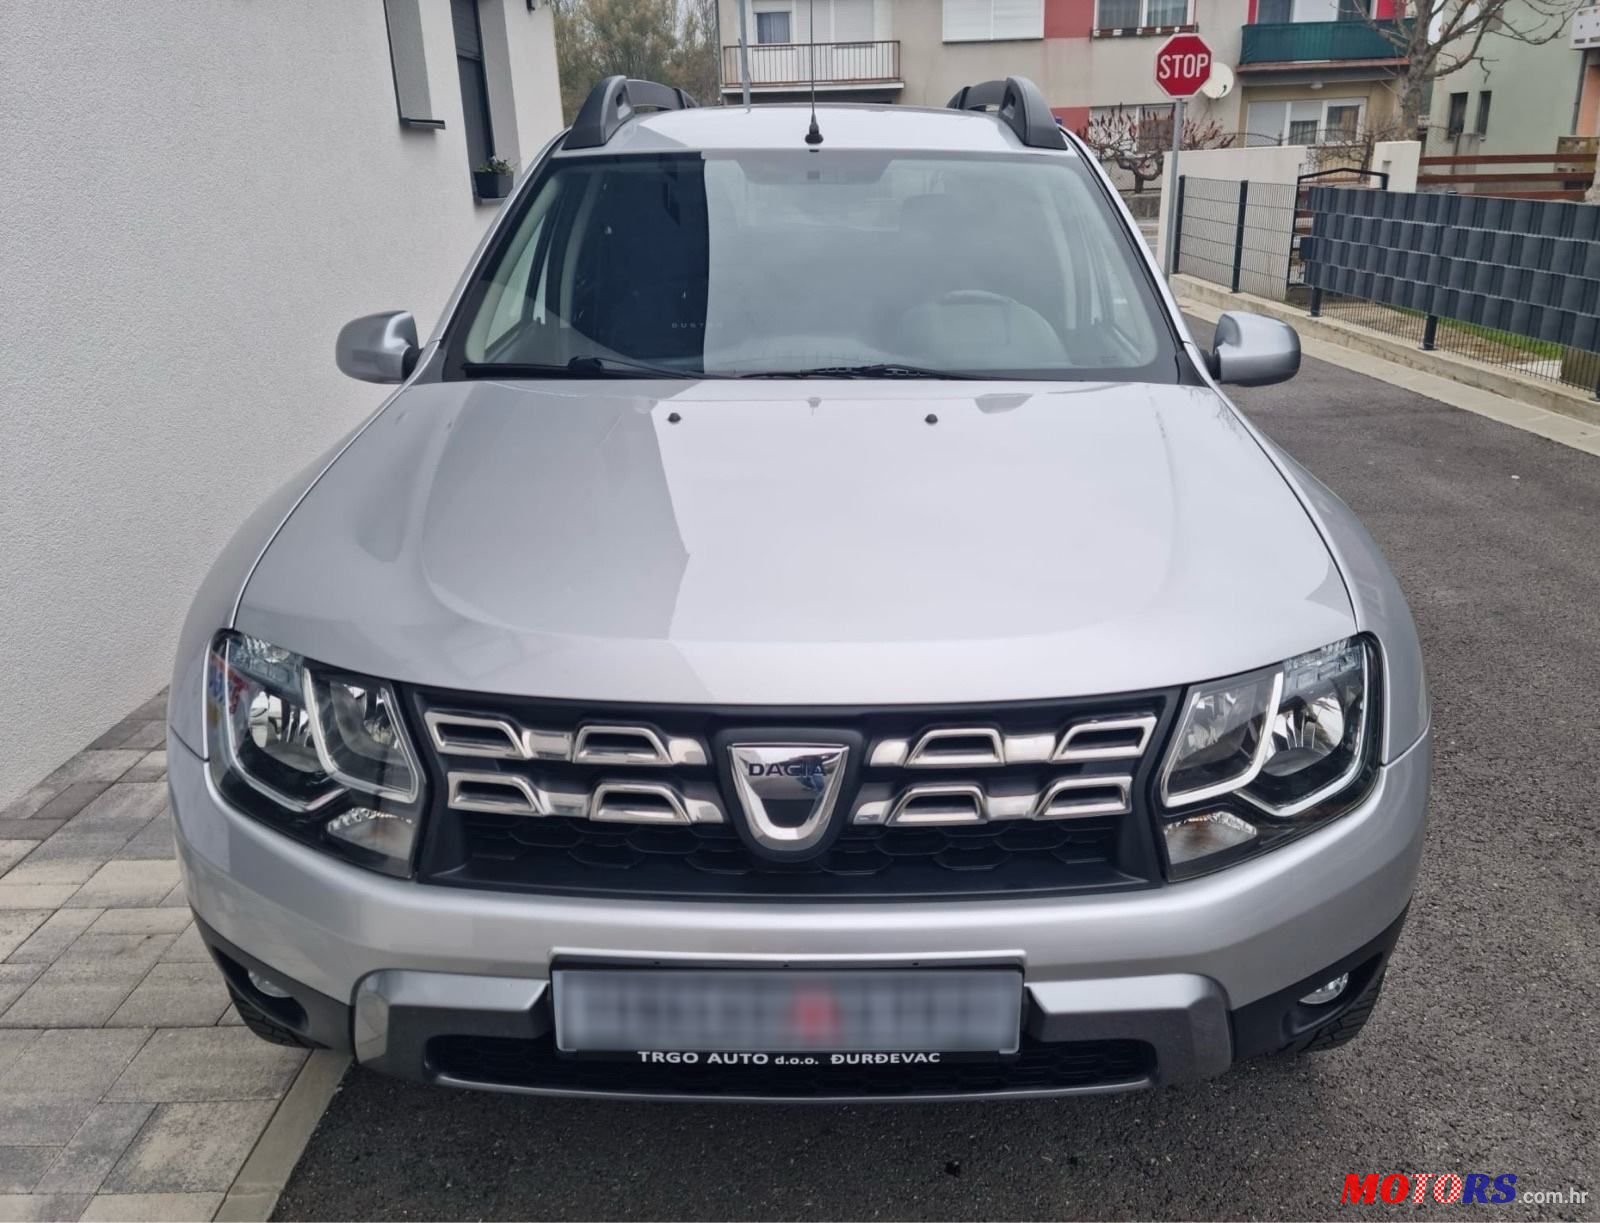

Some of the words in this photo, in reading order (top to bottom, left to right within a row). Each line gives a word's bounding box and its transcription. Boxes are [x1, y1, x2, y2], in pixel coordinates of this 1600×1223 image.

[1158, 53, 1209, 79] STOP
[748, 763, 826, 776] DACIA
[637, 1051, 699, 1064] TRGO
[707, 1053, 769, 1065] AUTO
[775, 1055, 819, 1065] d.o.o.
[830, 1053, 941, 1065] ĐURĐEVAC
